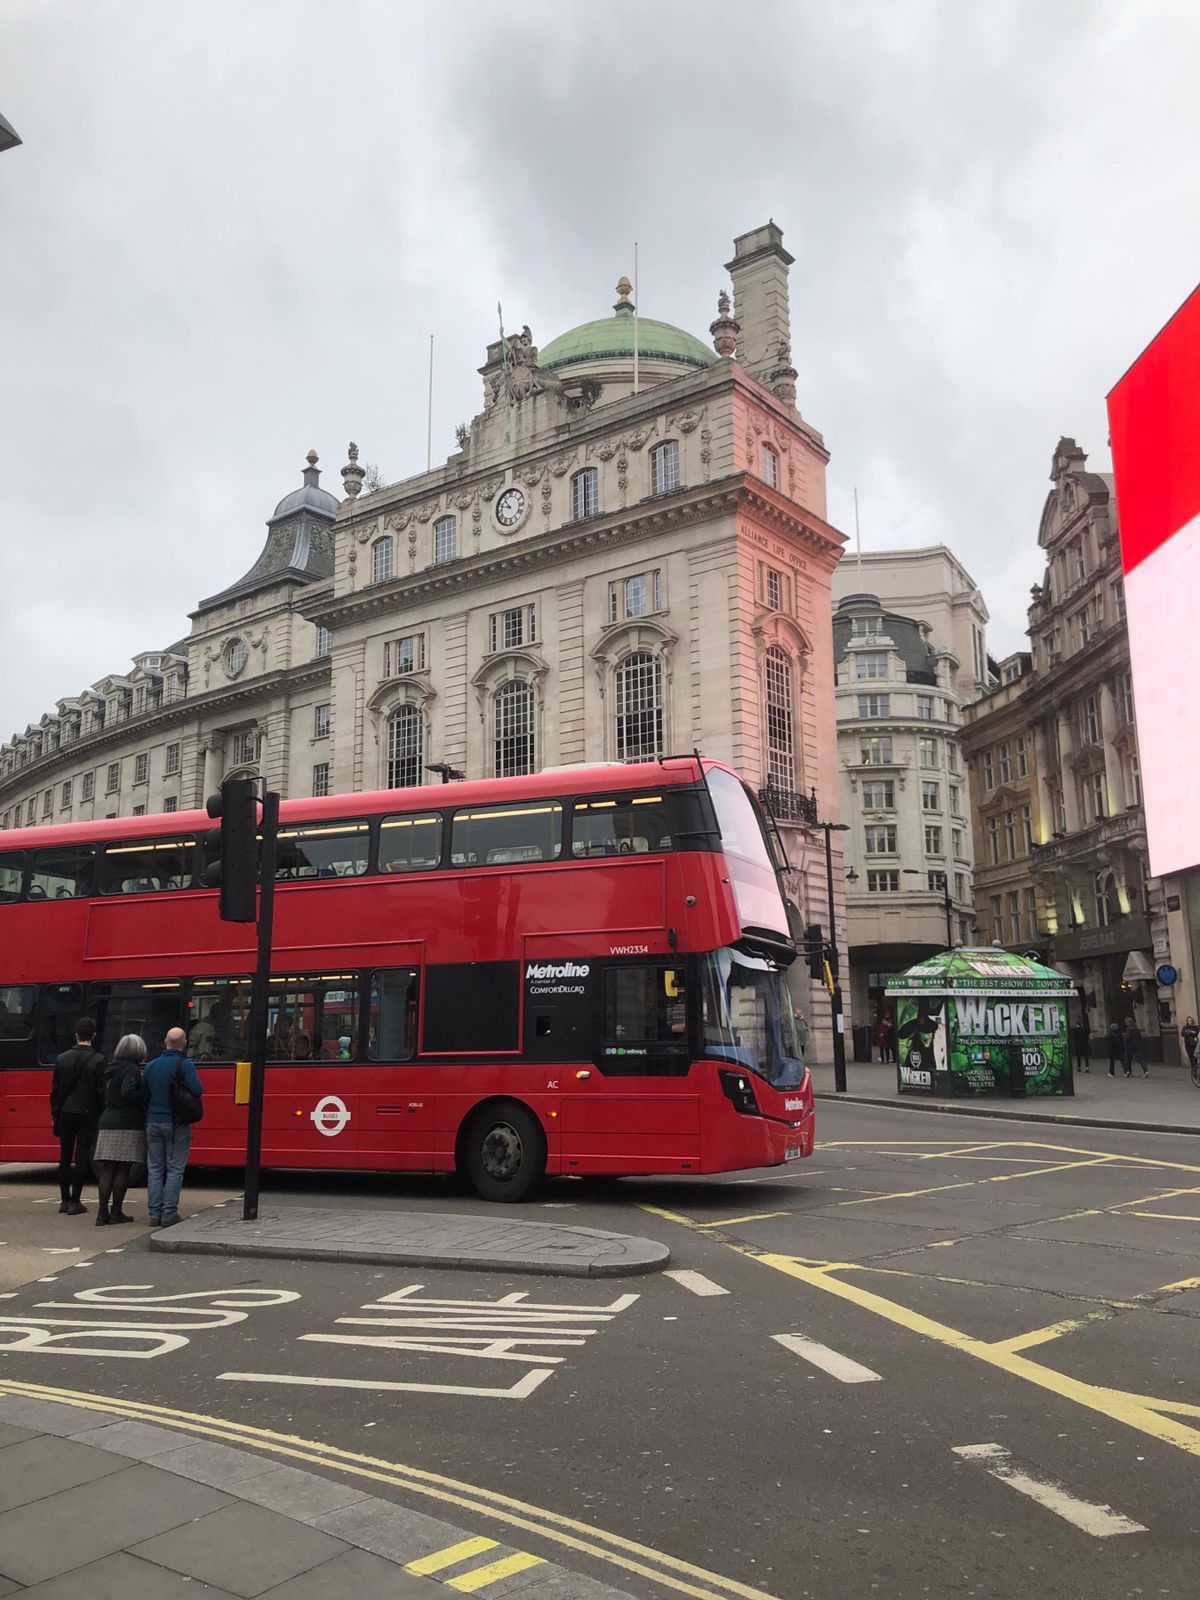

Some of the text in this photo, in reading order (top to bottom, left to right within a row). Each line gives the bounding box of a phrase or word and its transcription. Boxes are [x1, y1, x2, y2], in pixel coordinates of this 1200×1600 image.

[741, 525, 807, 571] ALLIANCE LIFE OFFICE
[609, 945, 648, 954] VWH2334
[526, 962, 590, 979] Metroline
[981, 980, 998, 988] BEST
[1001, 980, 1024, 988] SHOW
[1025, 980, 1034, 988] IN
[954, 996, 1060, 1036] WICKED
[1022, 1053, 1041, 1066] 100
[547, 1080, 559, 1089] AC
[899, 1066, 931, 1086] WICKED
[0, 1284, 302, 1359] BUS
[215, 1284, 641, 1399] LANE
